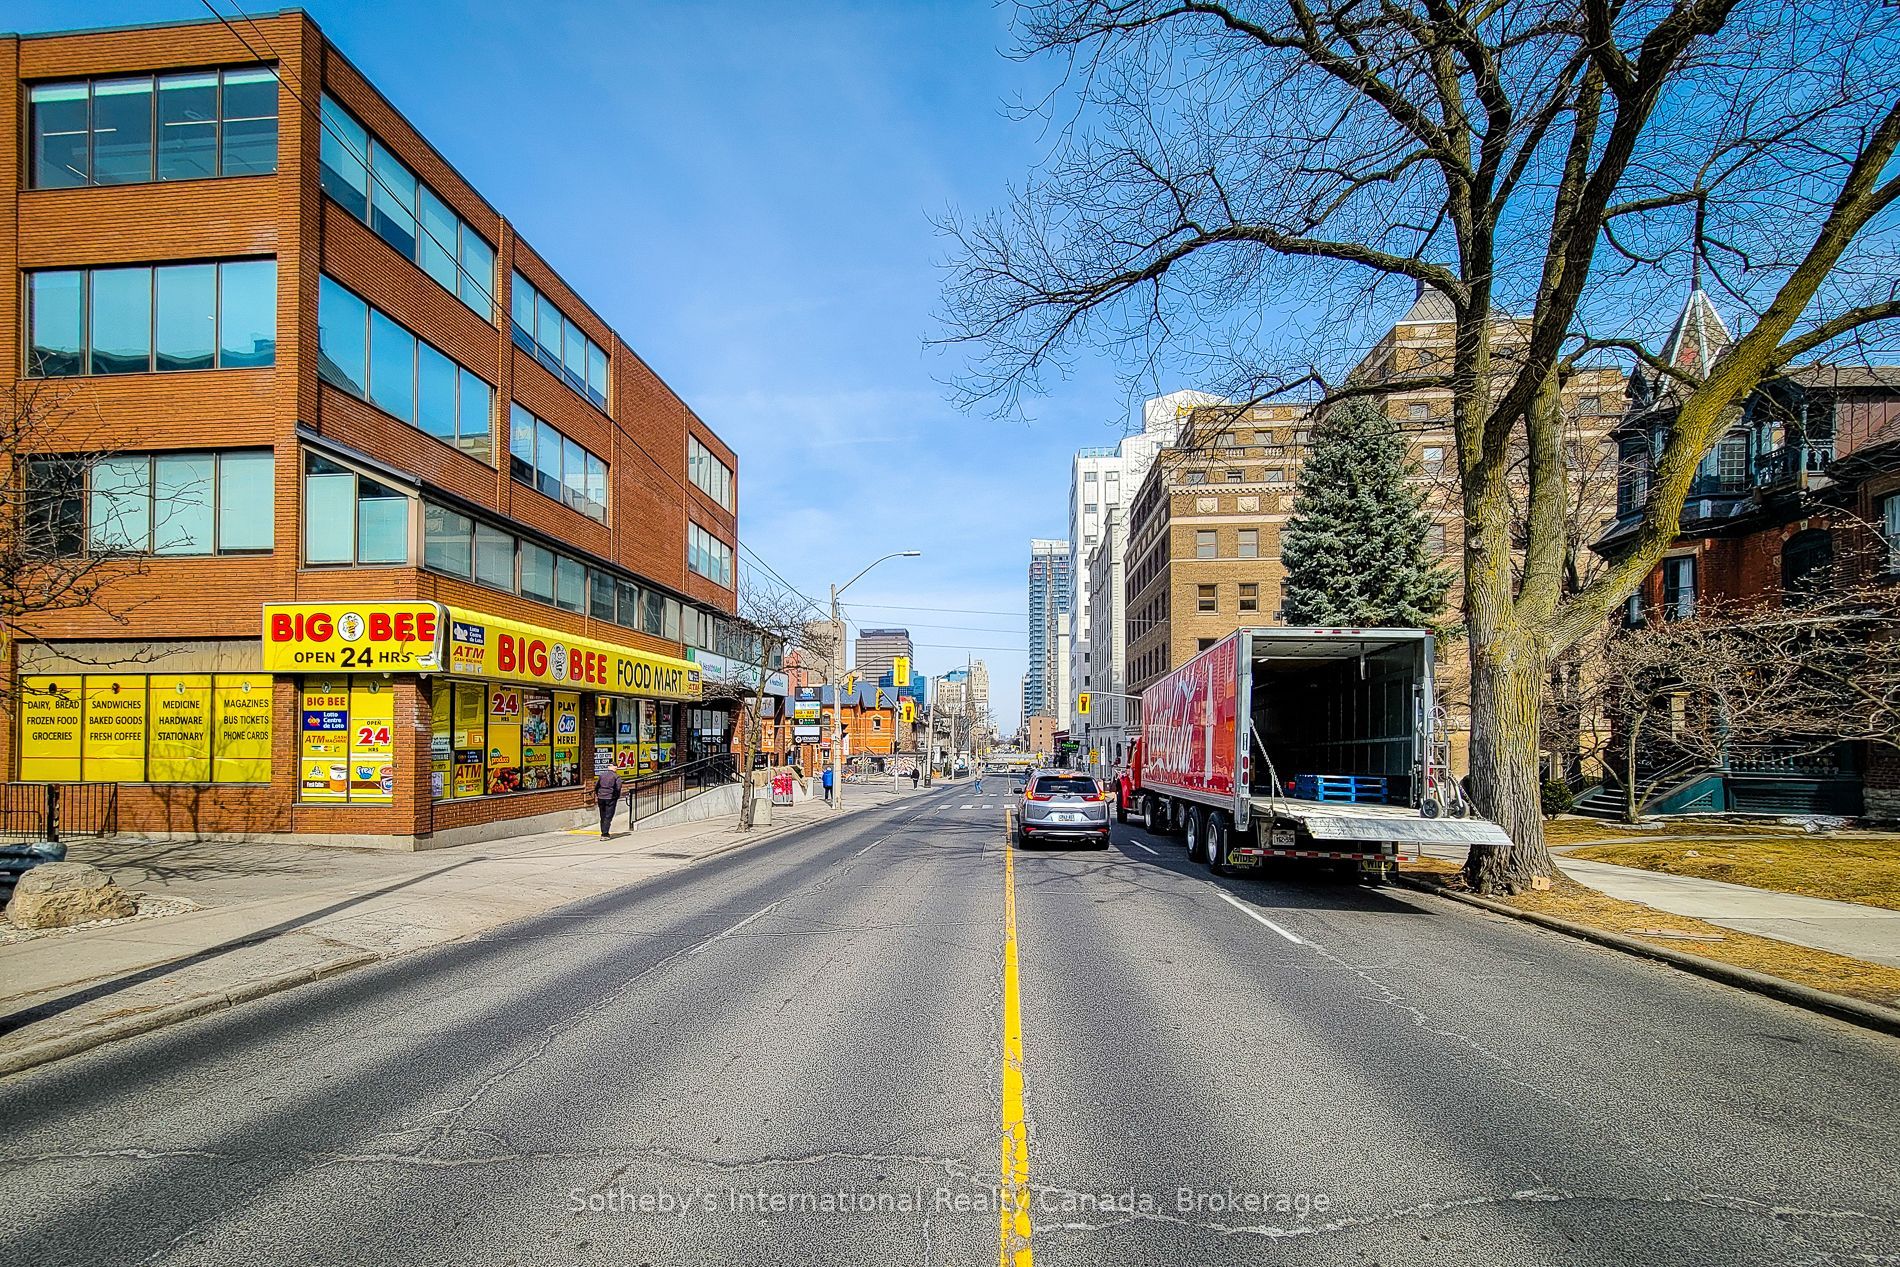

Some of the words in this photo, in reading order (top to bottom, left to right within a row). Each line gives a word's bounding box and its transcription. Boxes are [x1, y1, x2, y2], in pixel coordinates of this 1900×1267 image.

[271, 613, 334, 642] BIG
[369, 613, 436, 642] BEE
[453, 645, 484, 659] ATM
[294, 652, 335, 662] OPEN
[340, 647, 374, 668] 24
[379, 652, 412, 662] HRS
[498, 634, 547, 676] BIG
[570, 648, 607, 684] BEE
[618, 659, 651, 690] FOOD
[654, 666, 682, 693] MART
[28, 701, 50, 710] DAIRY,
[92, 701, 141, 709] SANDWICHES
[224, 700, 269, 708] MAGAZINES
[306, 697, 324, 706] BIG
[328, 697, 345, 706] BEE
[492, 692, 518, 714] 24
[558, 702, 576, 711] PLAY
[224, 716, 238, 724] BUS
[240, 716, 269, 724] TICKETS
[32, 732, 72, 740] GROCERIES
[158, 732, 204, 740] STATIONARY
[224, 732, 245, 740] PHONE
[247, 732, 269, 740] CARDS
[304, 735, 325, 744] ATM
[358, 727, 390, 744] 24
[558, 736, 576, 744] HERE!
[618, 751, 635, 768] 24
[455, 765, 482, 778] ATM
[1232, 854, 1254, 863] WIDE
